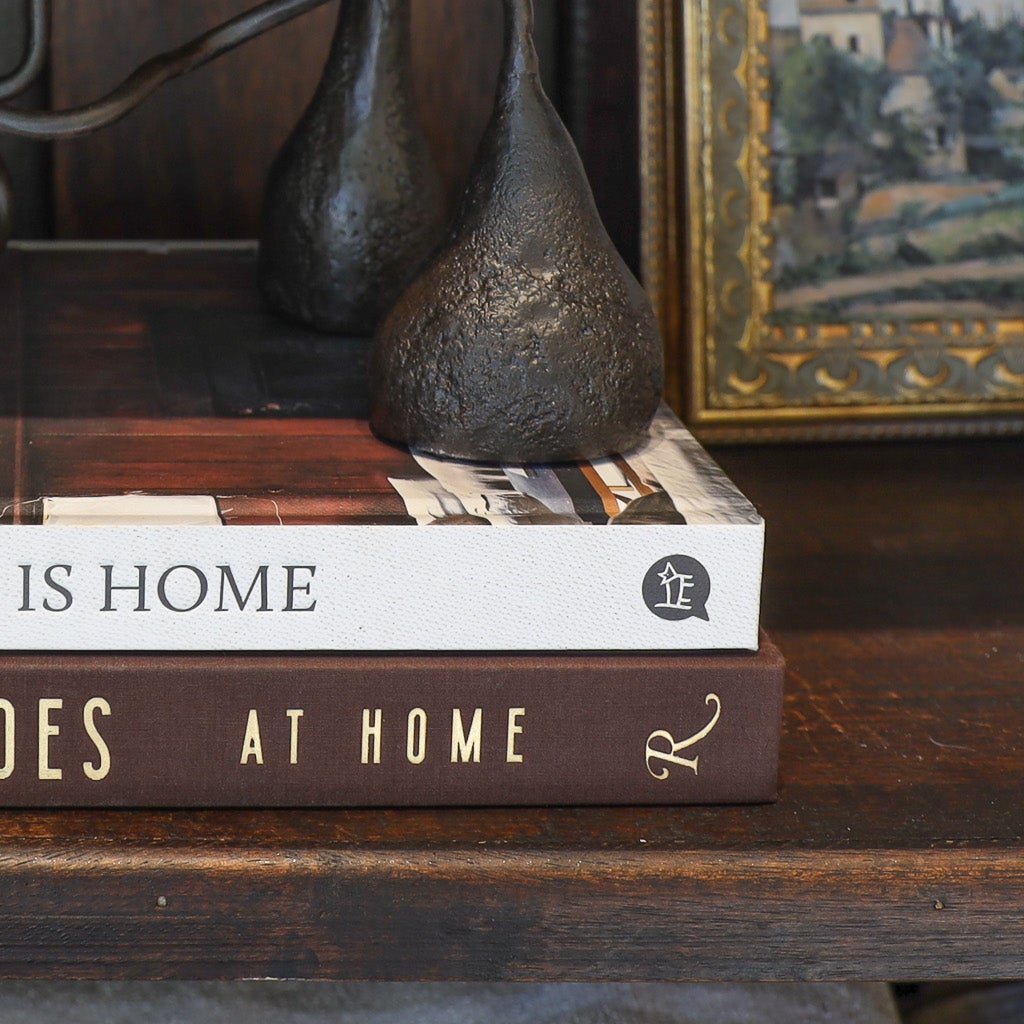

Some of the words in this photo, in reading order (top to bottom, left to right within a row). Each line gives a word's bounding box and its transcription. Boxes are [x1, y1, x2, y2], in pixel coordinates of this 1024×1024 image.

[18, 565, 73, 612] IS
[100, 565, 317, 612] HOME
[240, 710, 303, 764] AT
[361, 708, 525, 763] HOME
[646, 694, 721, 779] R
